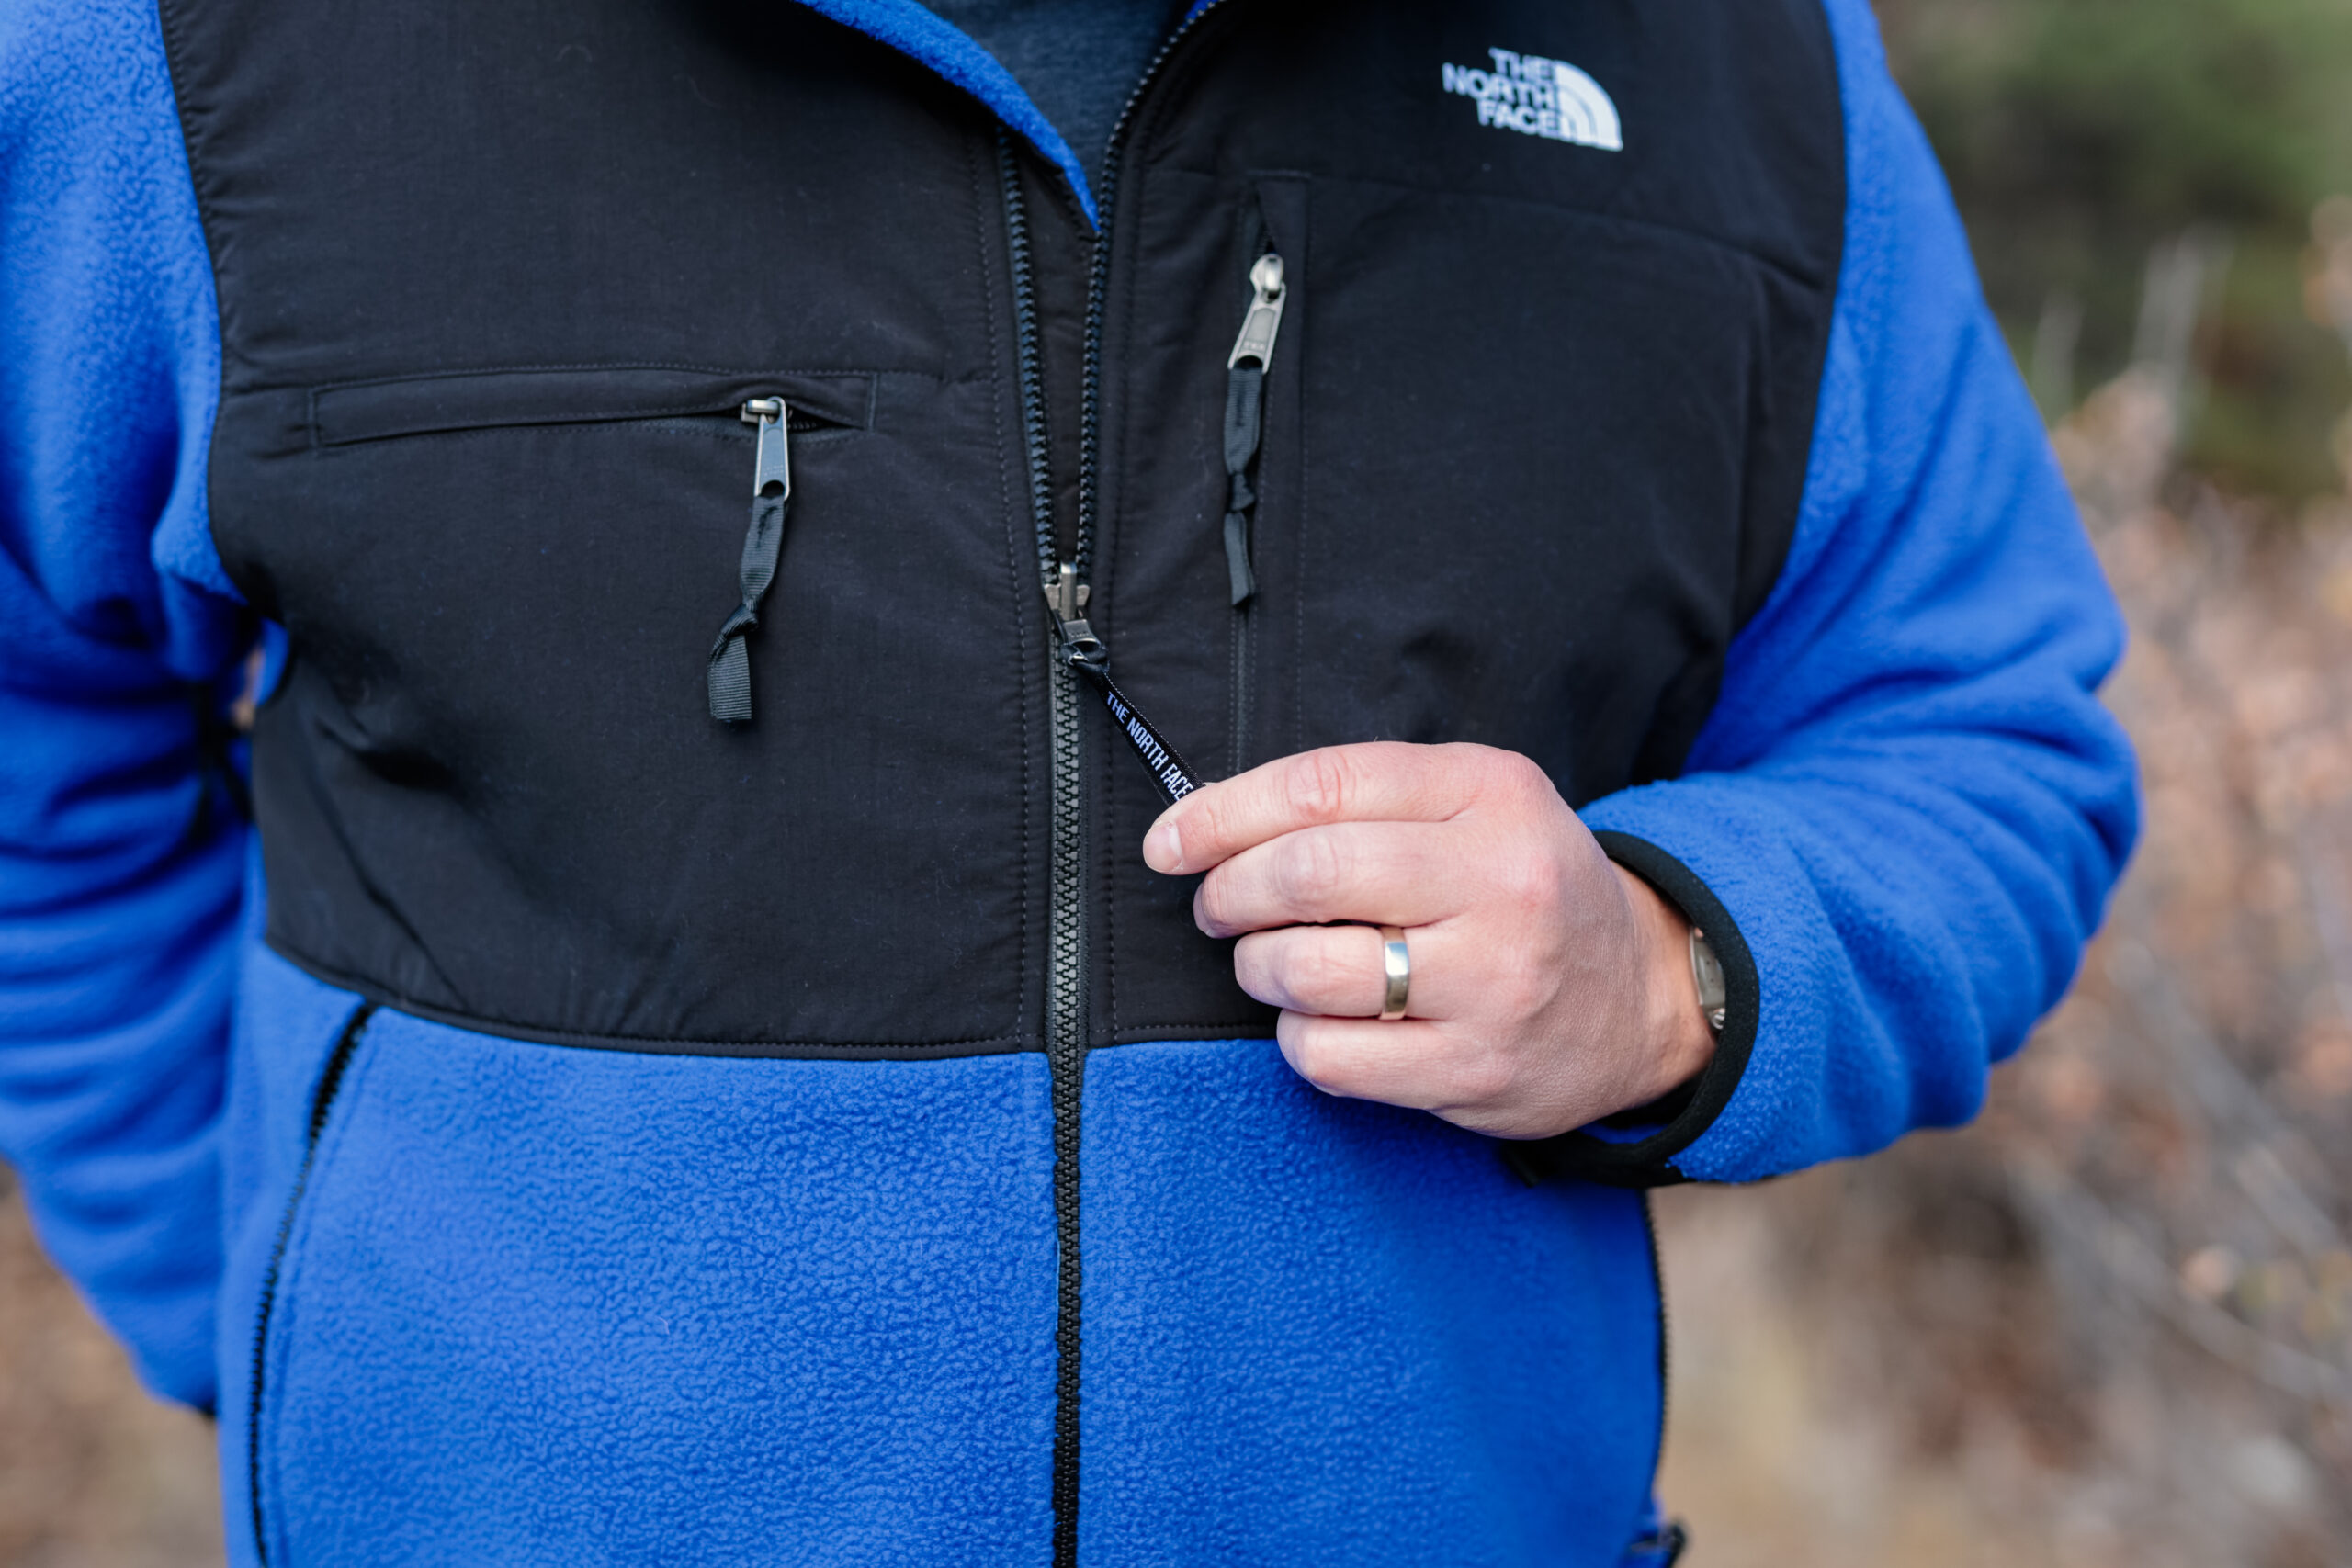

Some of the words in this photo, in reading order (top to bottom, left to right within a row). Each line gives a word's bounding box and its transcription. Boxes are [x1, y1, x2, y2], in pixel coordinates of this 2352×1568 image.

[1488, 46, 1555, 81] THE
[1442, 62, 1556, 109] NORTH
[1477, 99, 1560, 138] FACE
[1106, 691, 1130, 724] THE
[1126, 716, 1170, 771] NORTH
[1160, 763, 1193, 801] FACE
